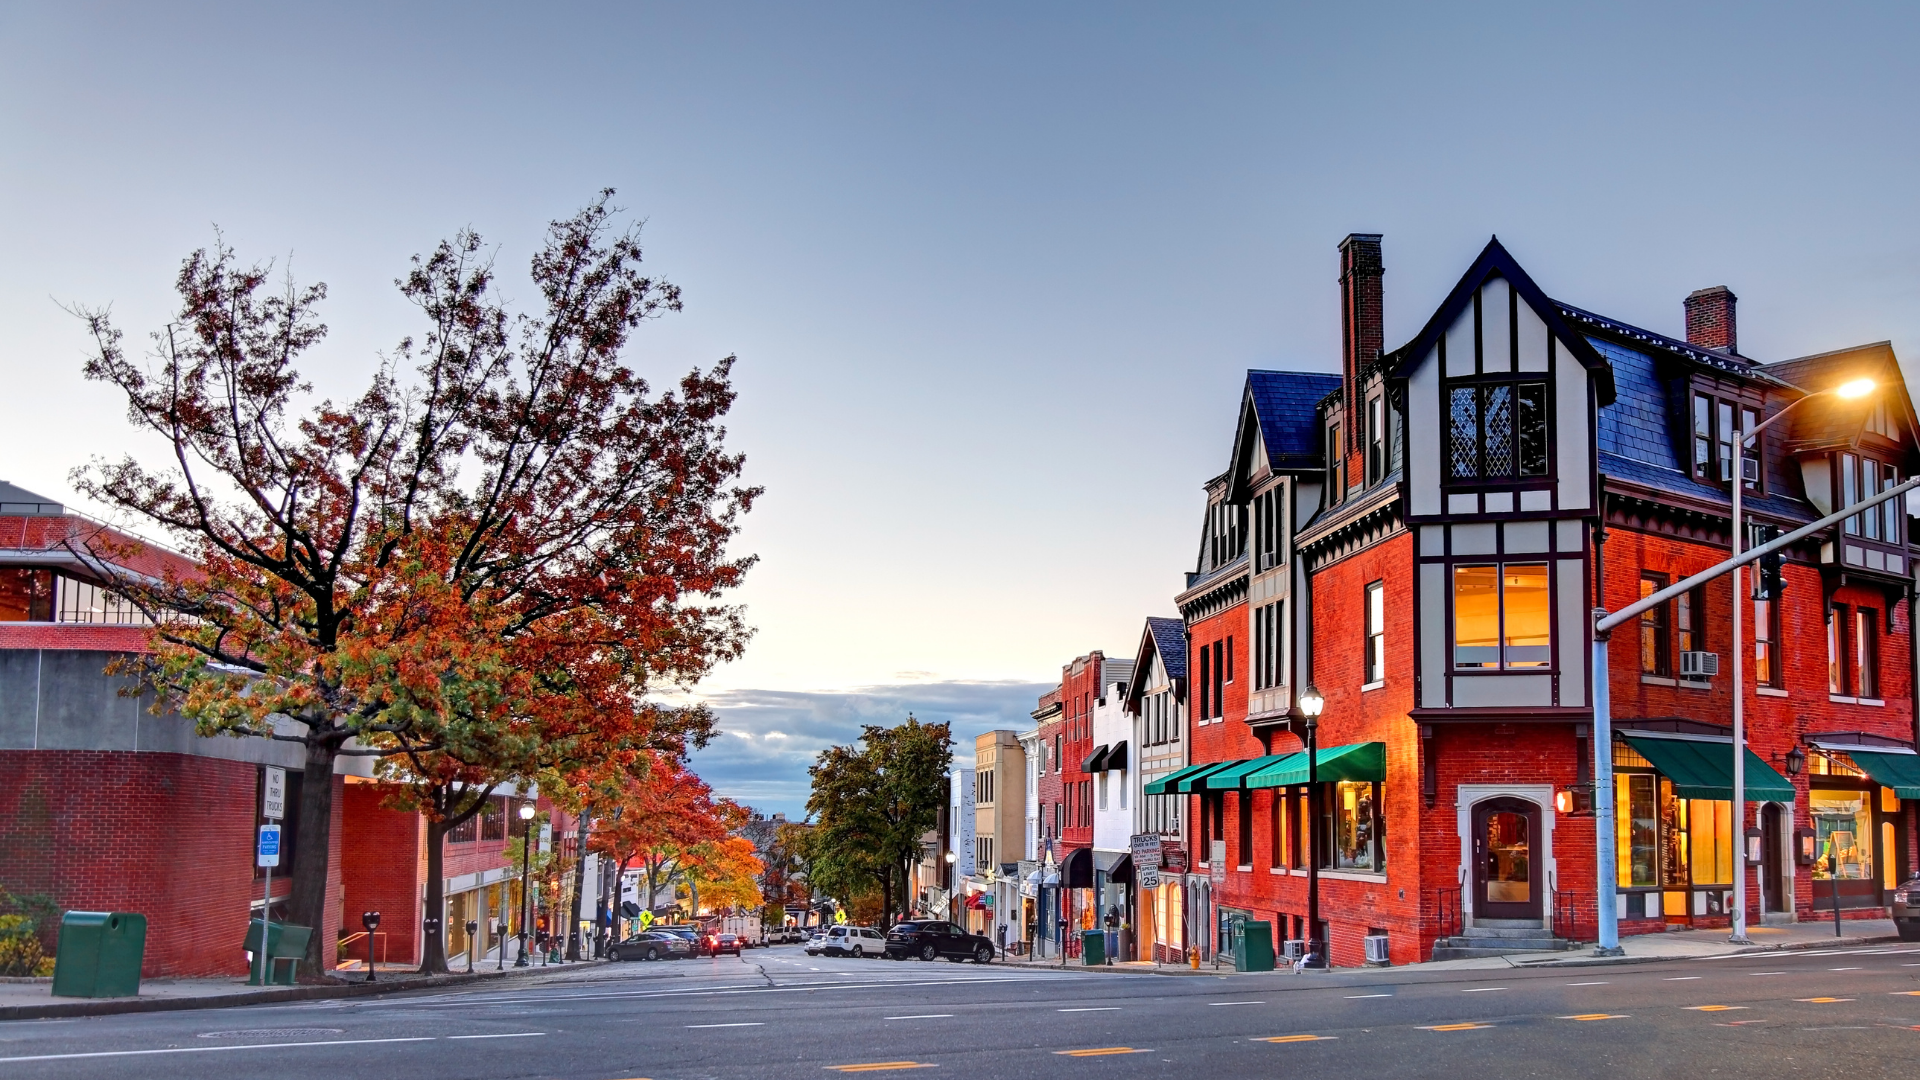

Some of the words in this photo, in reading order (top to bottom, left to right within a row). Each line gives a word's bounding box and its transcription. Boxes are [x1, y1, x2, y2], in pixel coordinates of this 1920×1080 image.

[272, 774, 279, 784] NO
[269, 787, 281, 798] THRU
[266, 800, 282, 812] TRUCKS
[1133, 835, 1158, 843] TRUCKS
[1143, 876, 1157, 887] 25
